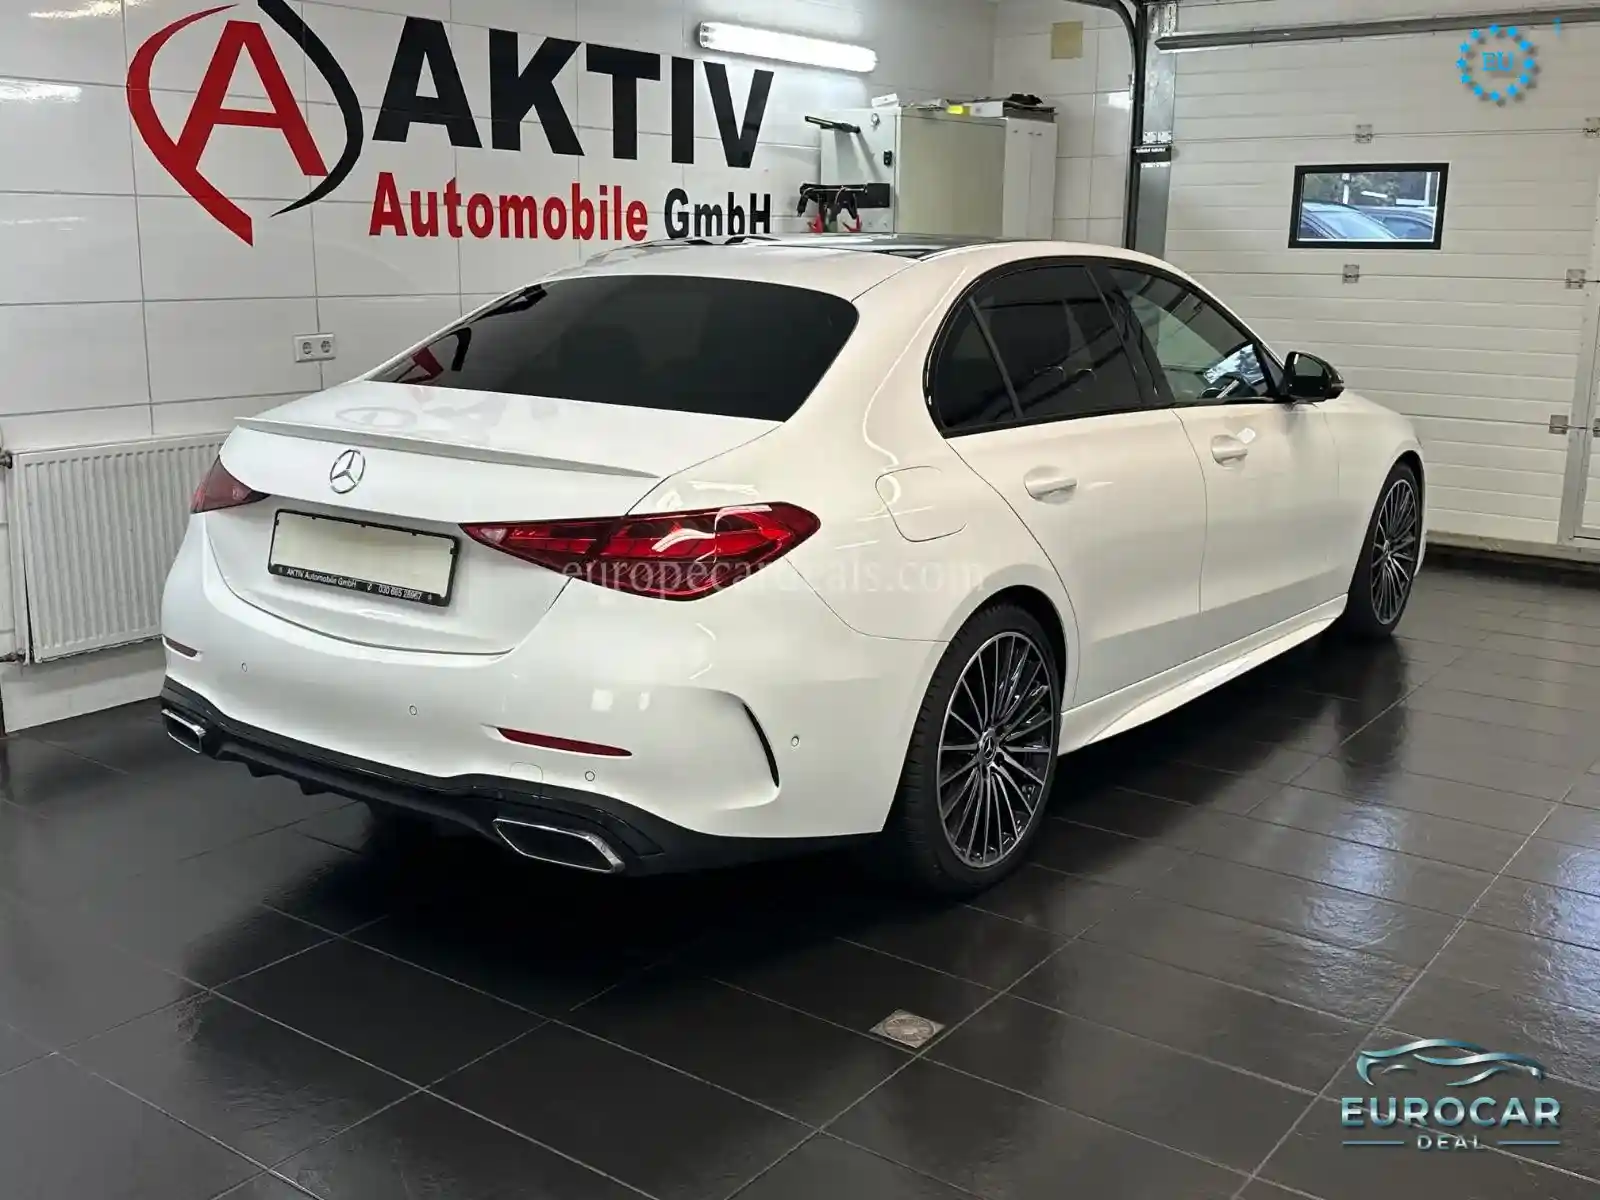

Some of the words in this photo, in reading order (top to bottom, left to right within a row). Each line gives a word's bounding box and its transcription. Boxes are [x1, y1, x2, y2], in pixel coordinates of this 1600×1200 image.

[372, 15, 775, 169] AKTIV
[368, 171, 648, 241] Automobile
[664, 187, 771, 239] GmbH
[286, 567, 304, 578] AKTIV
[304, 571, 337, 585] Automobile
[337, 577, 357, 588] GmbH
[378, 583, 390, 595] 030
